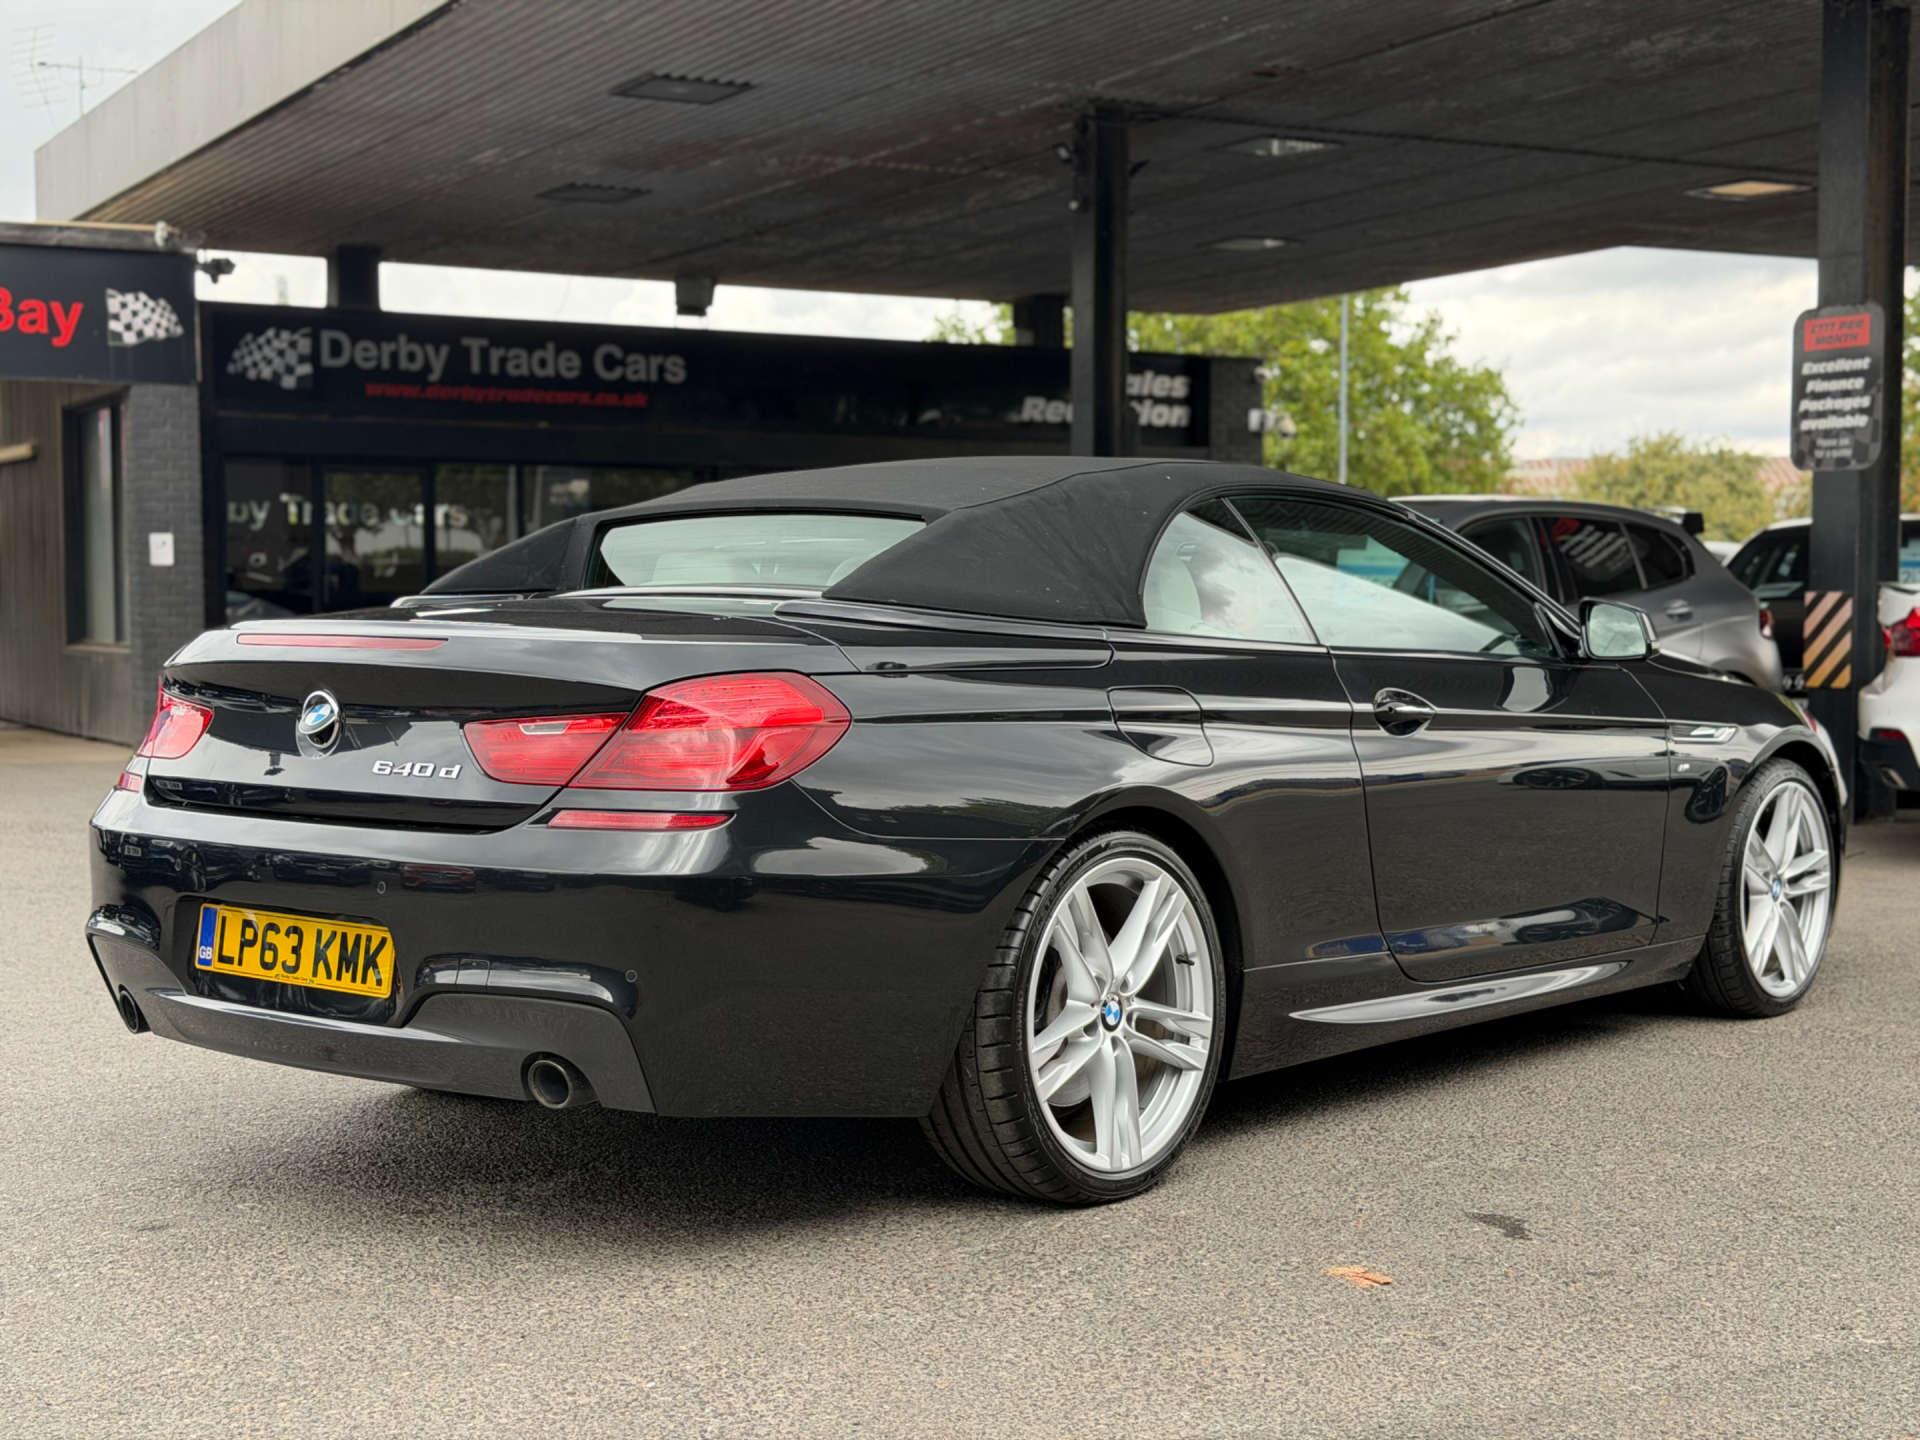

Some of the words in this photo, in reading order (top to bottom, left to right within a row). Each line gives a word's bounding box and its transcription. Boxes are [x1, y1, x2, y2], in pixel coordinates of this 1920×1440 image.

[319, 328, 450, 383] Derby
[460, 336, 583, 380] Trade
[593, 342, 687, 385] Cars
[200, 945, 213, 960] GB
[217, 915, 305, 975] LP63
[312, 927, 388, 987] KMK
